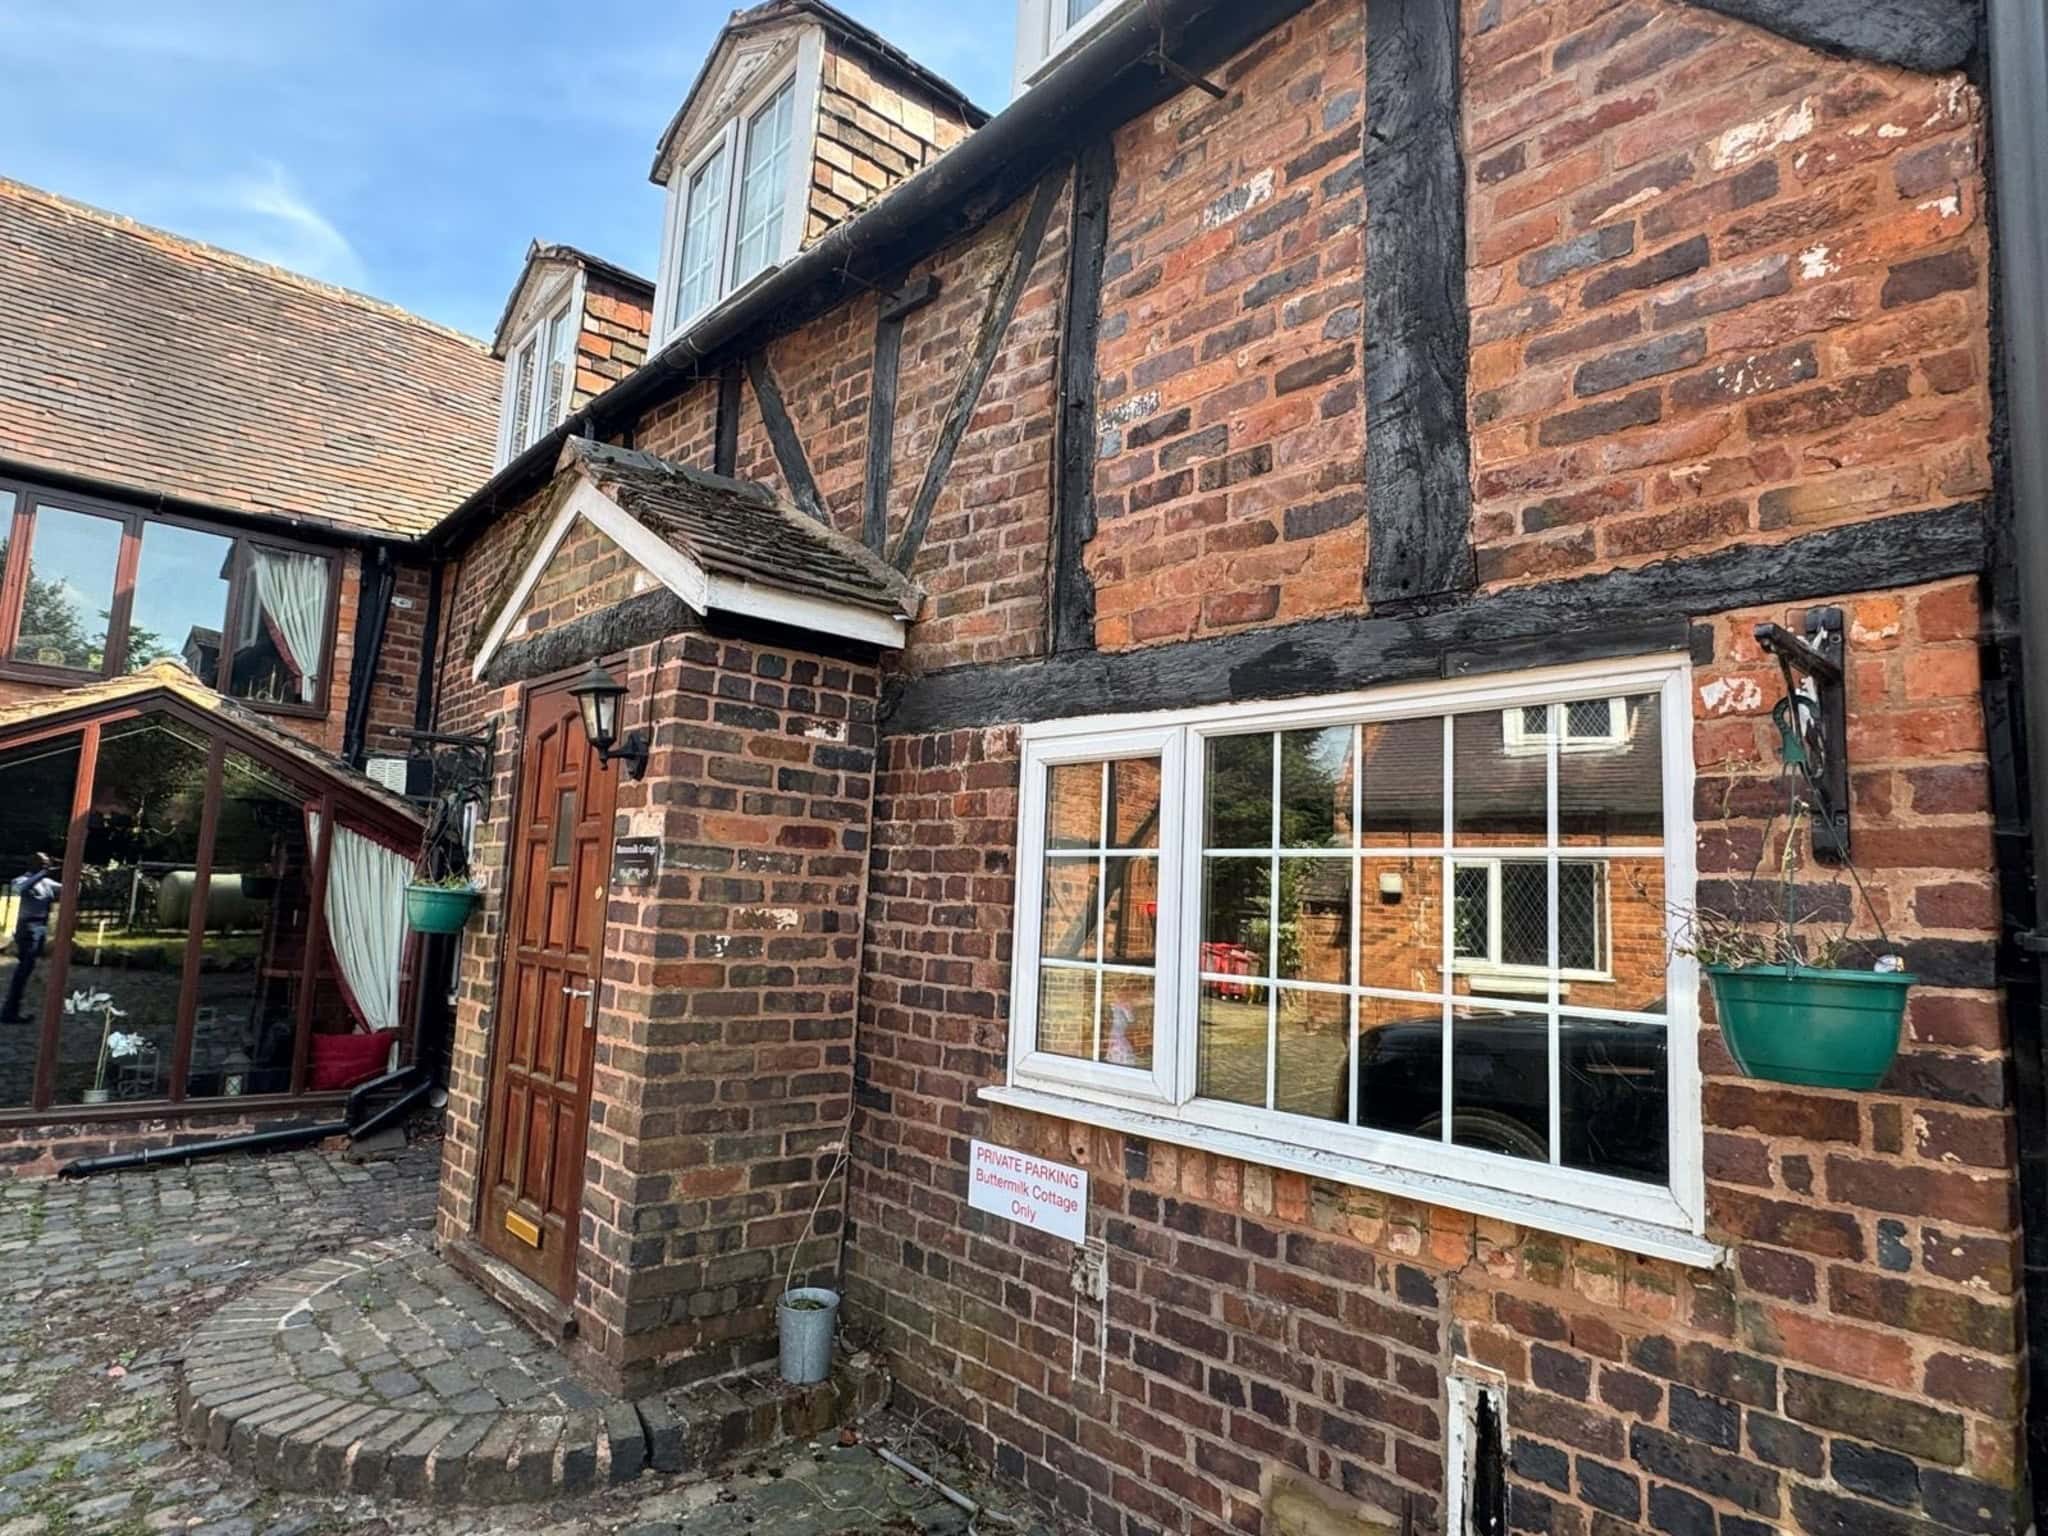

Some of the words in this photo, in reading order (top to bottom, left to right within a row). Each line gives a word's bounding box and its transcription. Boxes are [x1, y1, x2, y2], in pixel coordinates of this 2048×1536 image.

[977, 1147, 1022, 1172] PRIVATE
[1025, 1161, 1079, 1189] PARKING
[976, 1168, 1029, 1196] Buttermilk
[1032, 1185, 1078, 1213] Cottage
[1011, 1200, 1037, 1222] Only
